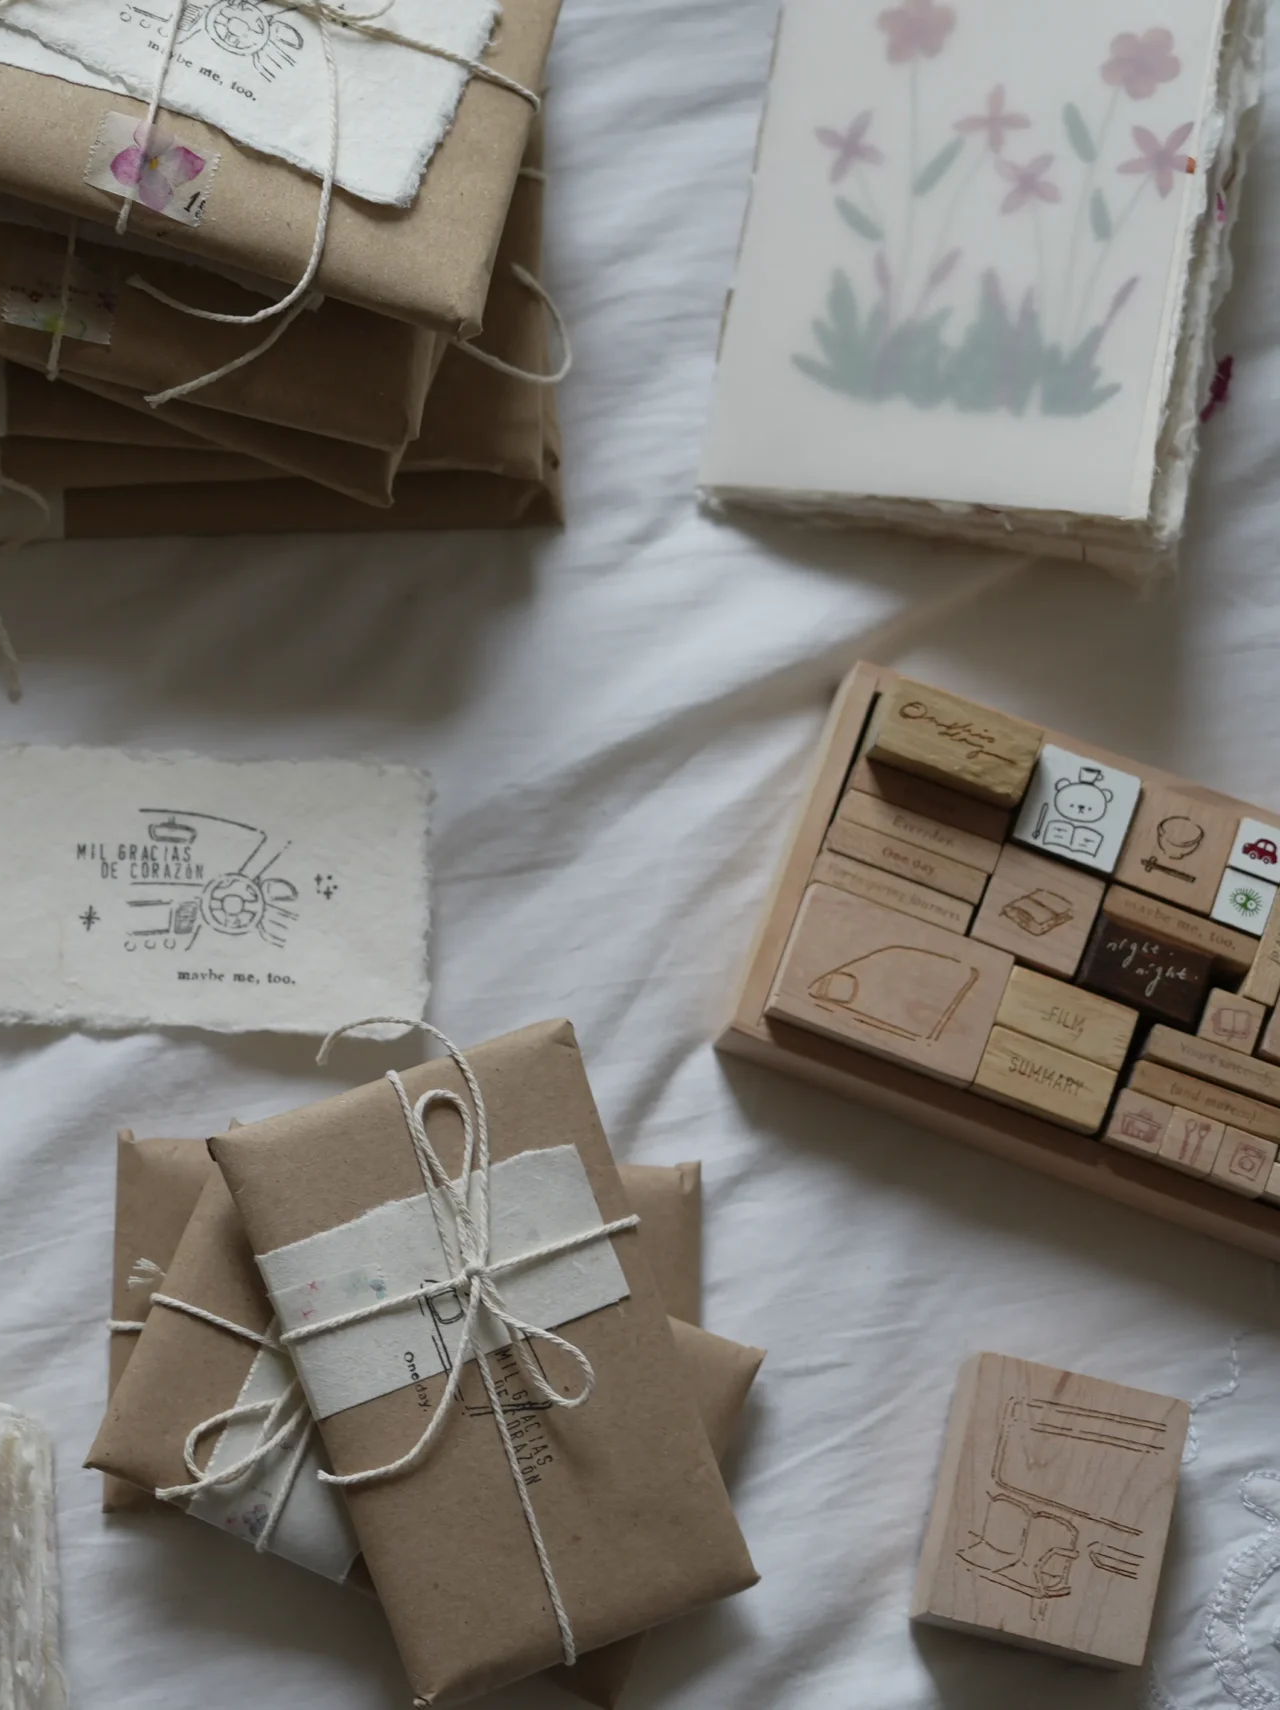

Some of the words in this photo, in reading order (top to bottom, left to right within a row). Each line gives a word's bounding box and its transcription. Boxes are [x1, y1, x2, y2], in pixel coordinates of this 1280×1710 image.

[199, 65, 223, 86] me,
[230, 81, 257, 101] too.
[76, 843, 106, 860] MIL
[118, 844, 192, 862] GRACIAS
[101, 862, 118, 879] DE
[1209, 930, 1237, 950] too.
[177, 968, 225, 982] maybe
[233, 972, 260, 984] me,
[267, 972, 296, 984] too.
[1008, 1056, 1084, 1096] SUMMARY
[495, 1347, 519, 1382] MIL
[403, 1351, 420, 1381] One
[415, 1384, 432, 1412] day.
